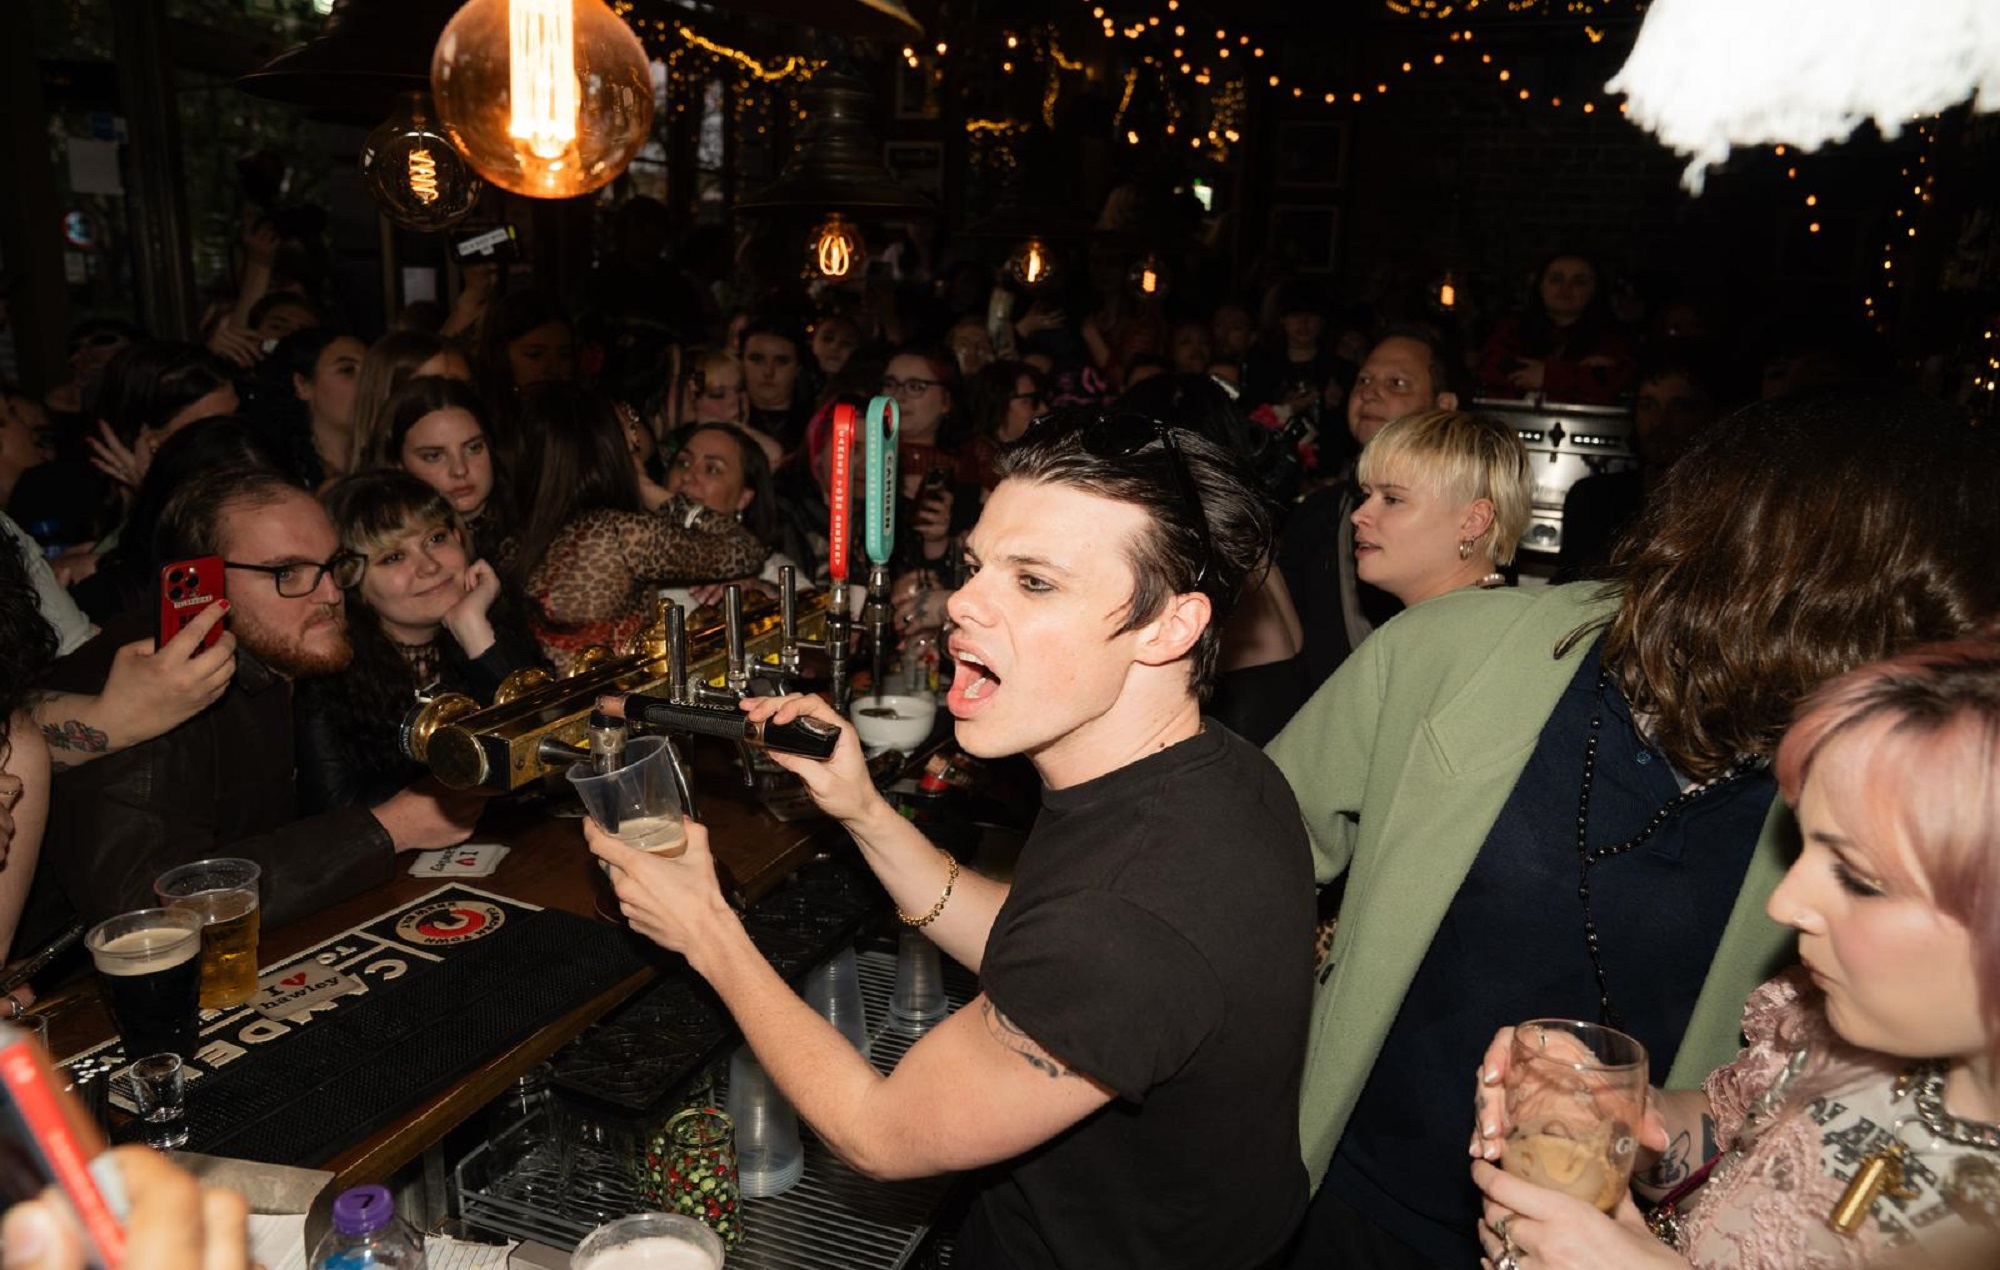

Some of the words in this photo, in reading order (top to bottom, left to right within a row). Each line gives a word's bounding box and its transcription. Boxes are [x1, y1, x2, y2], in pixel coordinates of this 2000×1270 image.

[836, 430, 846, 475] CAMDEN
[834, 480, 845, 510] TOWN
[259, 975, 339, 1010] hawley
[261, 984, 285, 998] I
